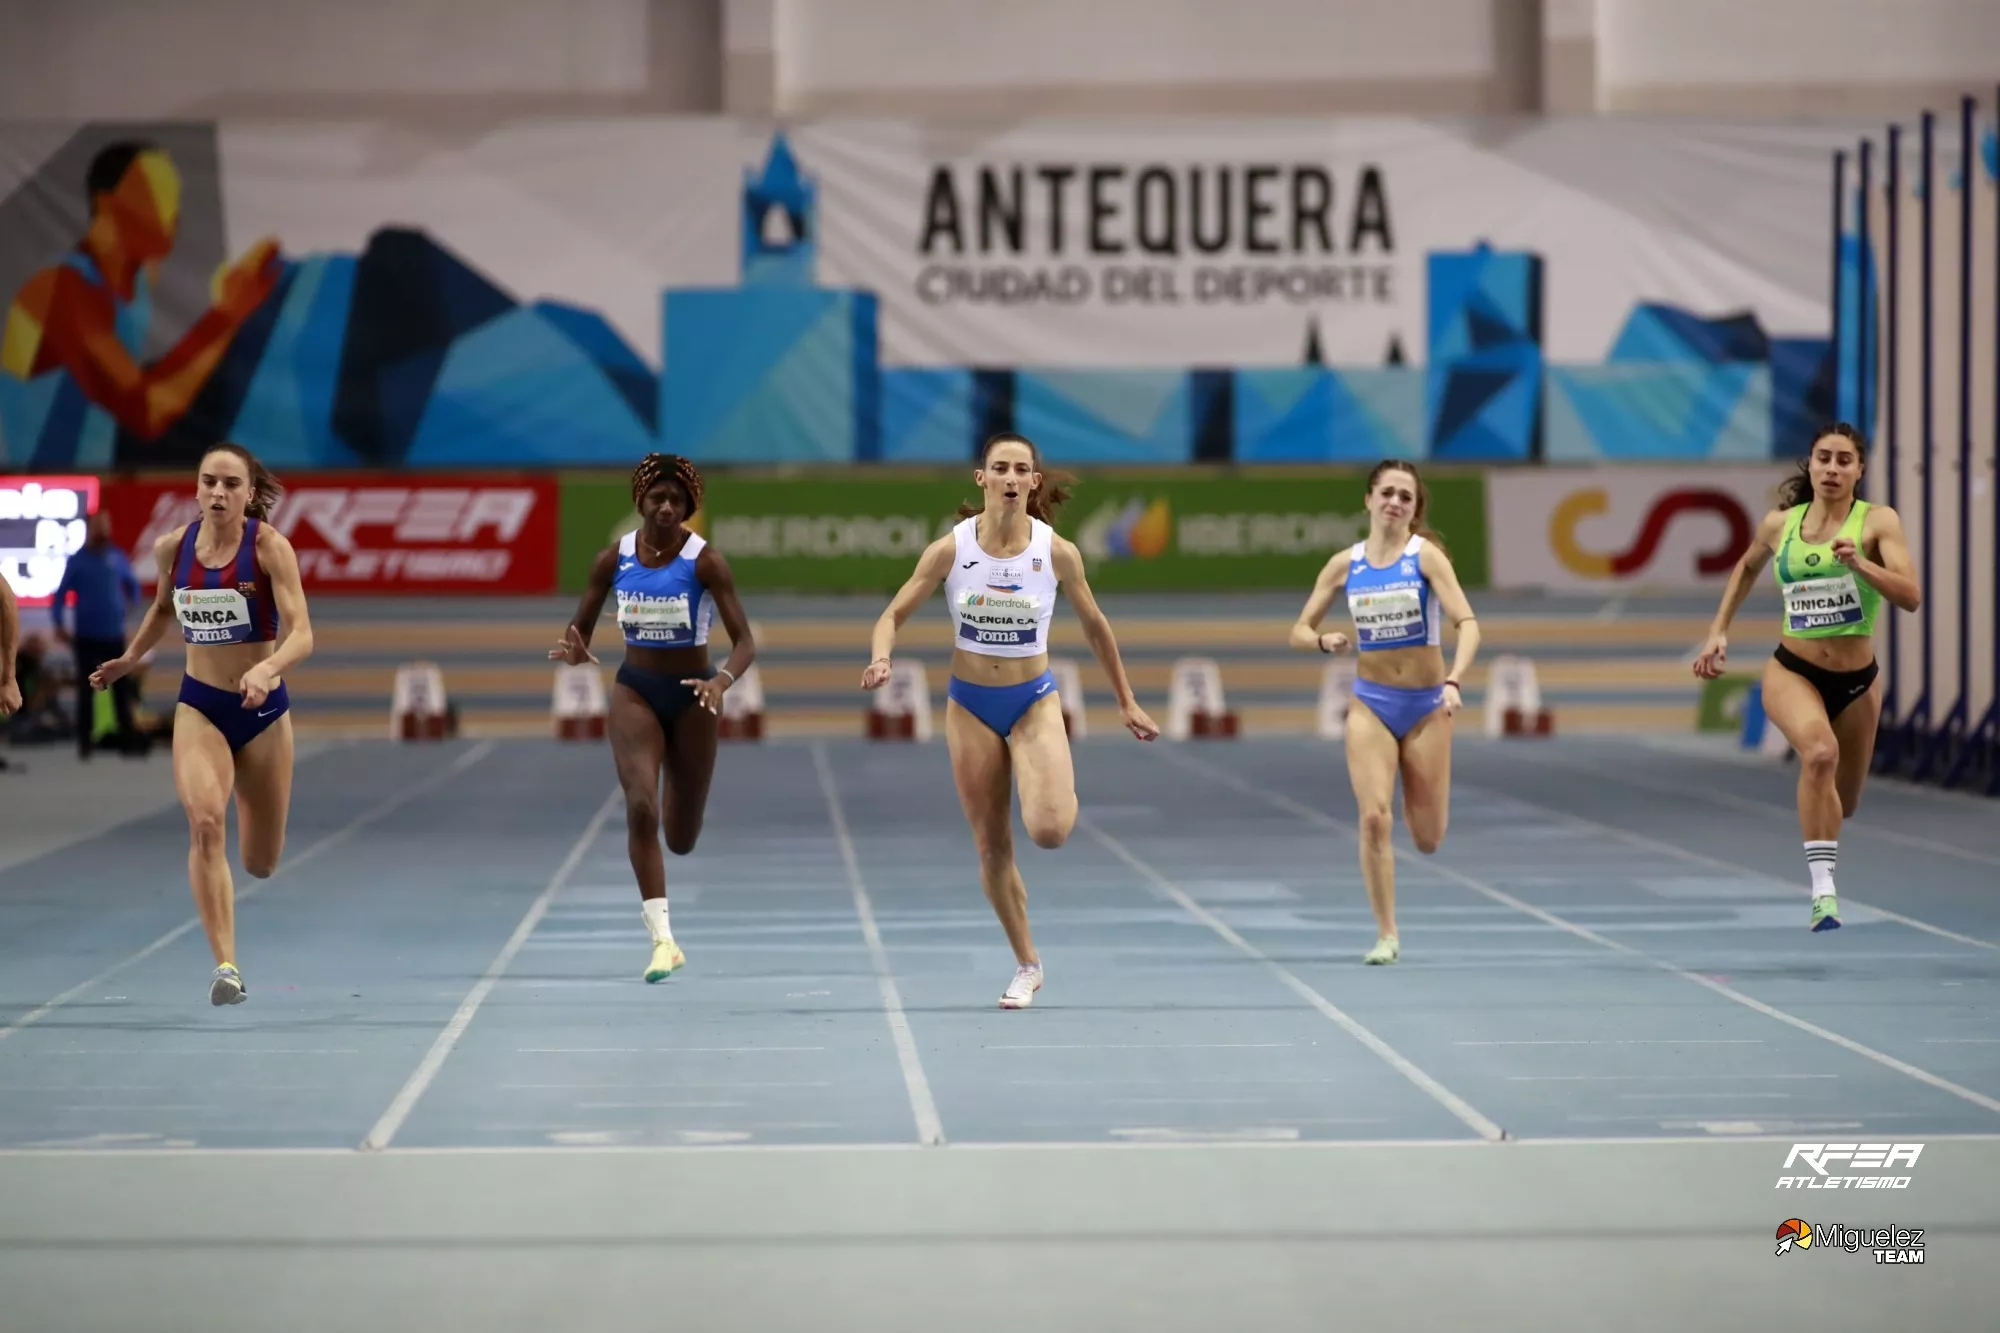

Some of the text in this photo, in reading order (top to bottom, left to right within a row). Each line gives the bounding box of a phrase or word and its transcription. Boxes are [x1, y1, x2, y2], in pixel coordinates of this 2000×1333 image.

[916, 164, 1394, 256] ANTEQUERA
[915, 264, 1394, 305] CIUDAD DEL DEPORTE
[298, 551, 512, 580] TLETISMO
[193, 594, 236, 605] Iberdrola
[986, 597, 1031, 609] Iberdrola
[1791, 594, 1855, 611] UNICAJA
[182, 610, 238, 626] BARÇA
[960, 612, 1014, 625] VALENCIA
[1805, 613, 1844, 627] Joma
[191, 629, 233, 643] Joma
[636, 629, 676, 641] Joma
[976, 629, 1020, 643] Joma
